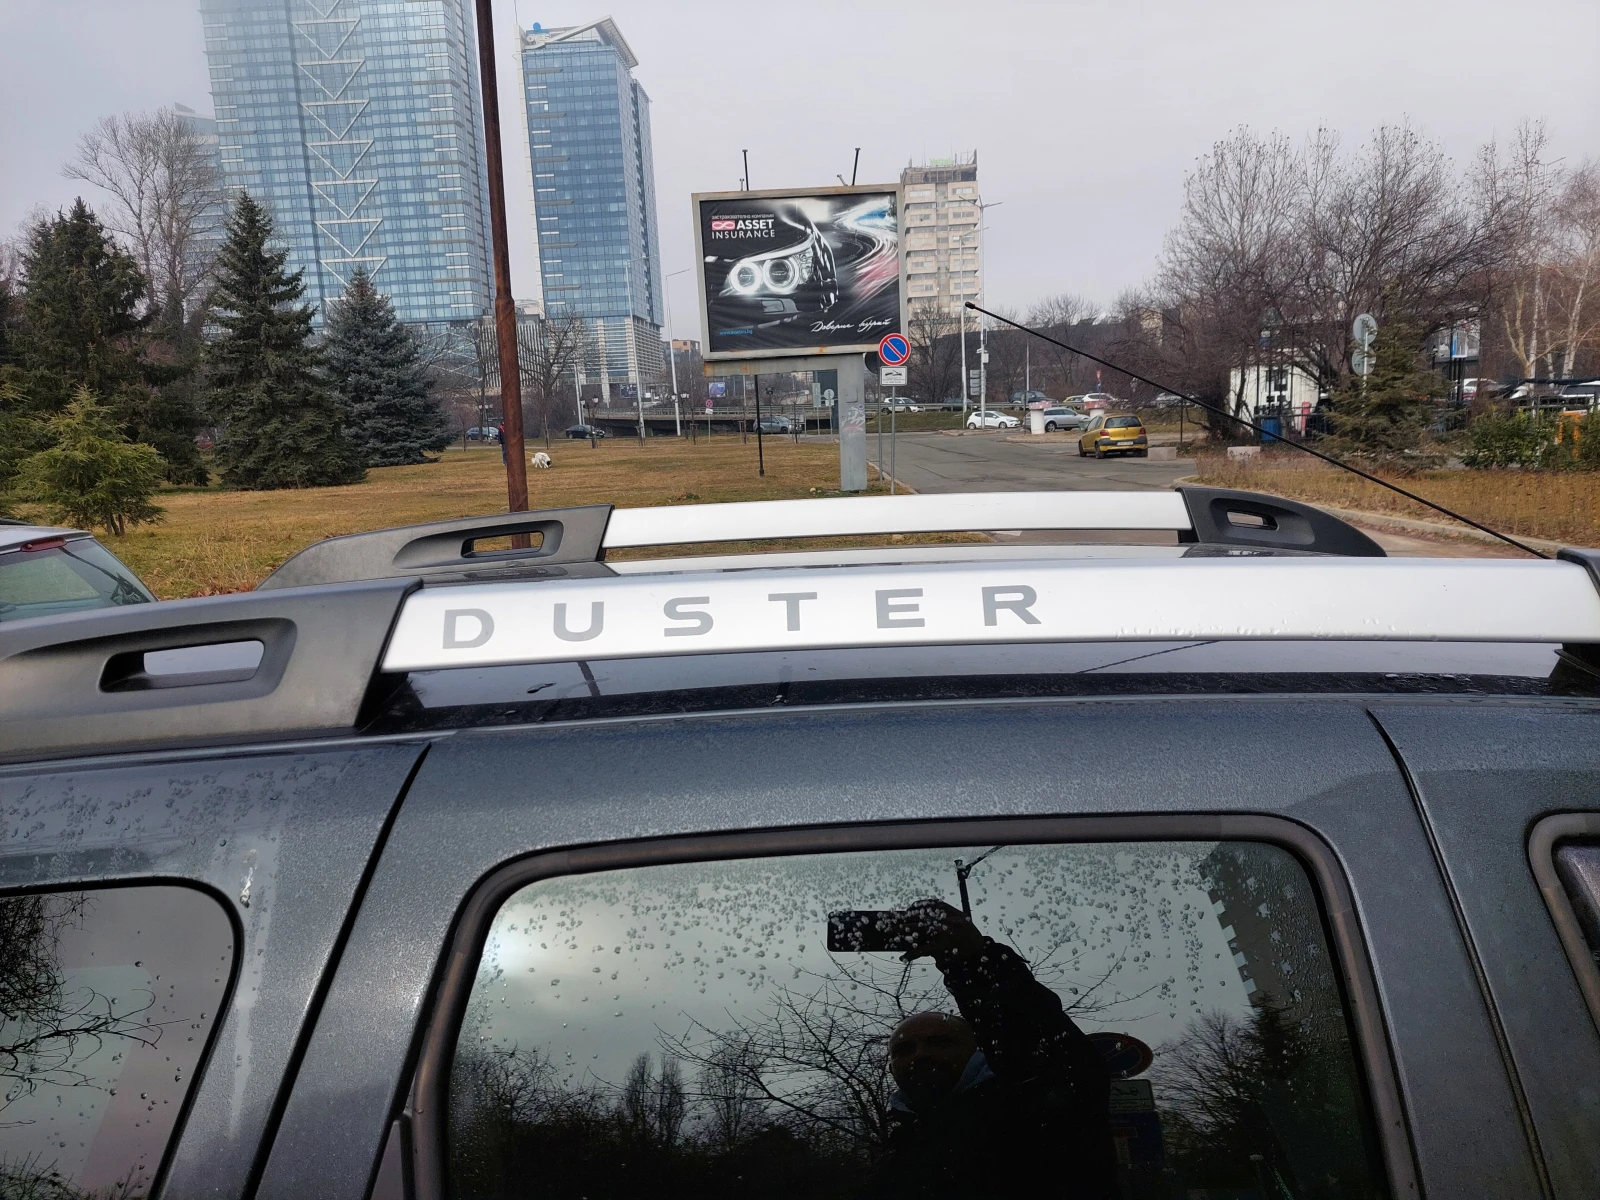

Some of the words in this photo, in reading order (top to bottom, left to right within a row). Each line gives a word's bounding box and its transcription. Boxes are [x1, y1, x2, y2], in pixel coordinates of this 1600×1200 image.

[736, 219, 775, 230] ASSET
[712, 229, 776, 239] INSURANCE
[441, 584, 1042, 650] DUSTER
